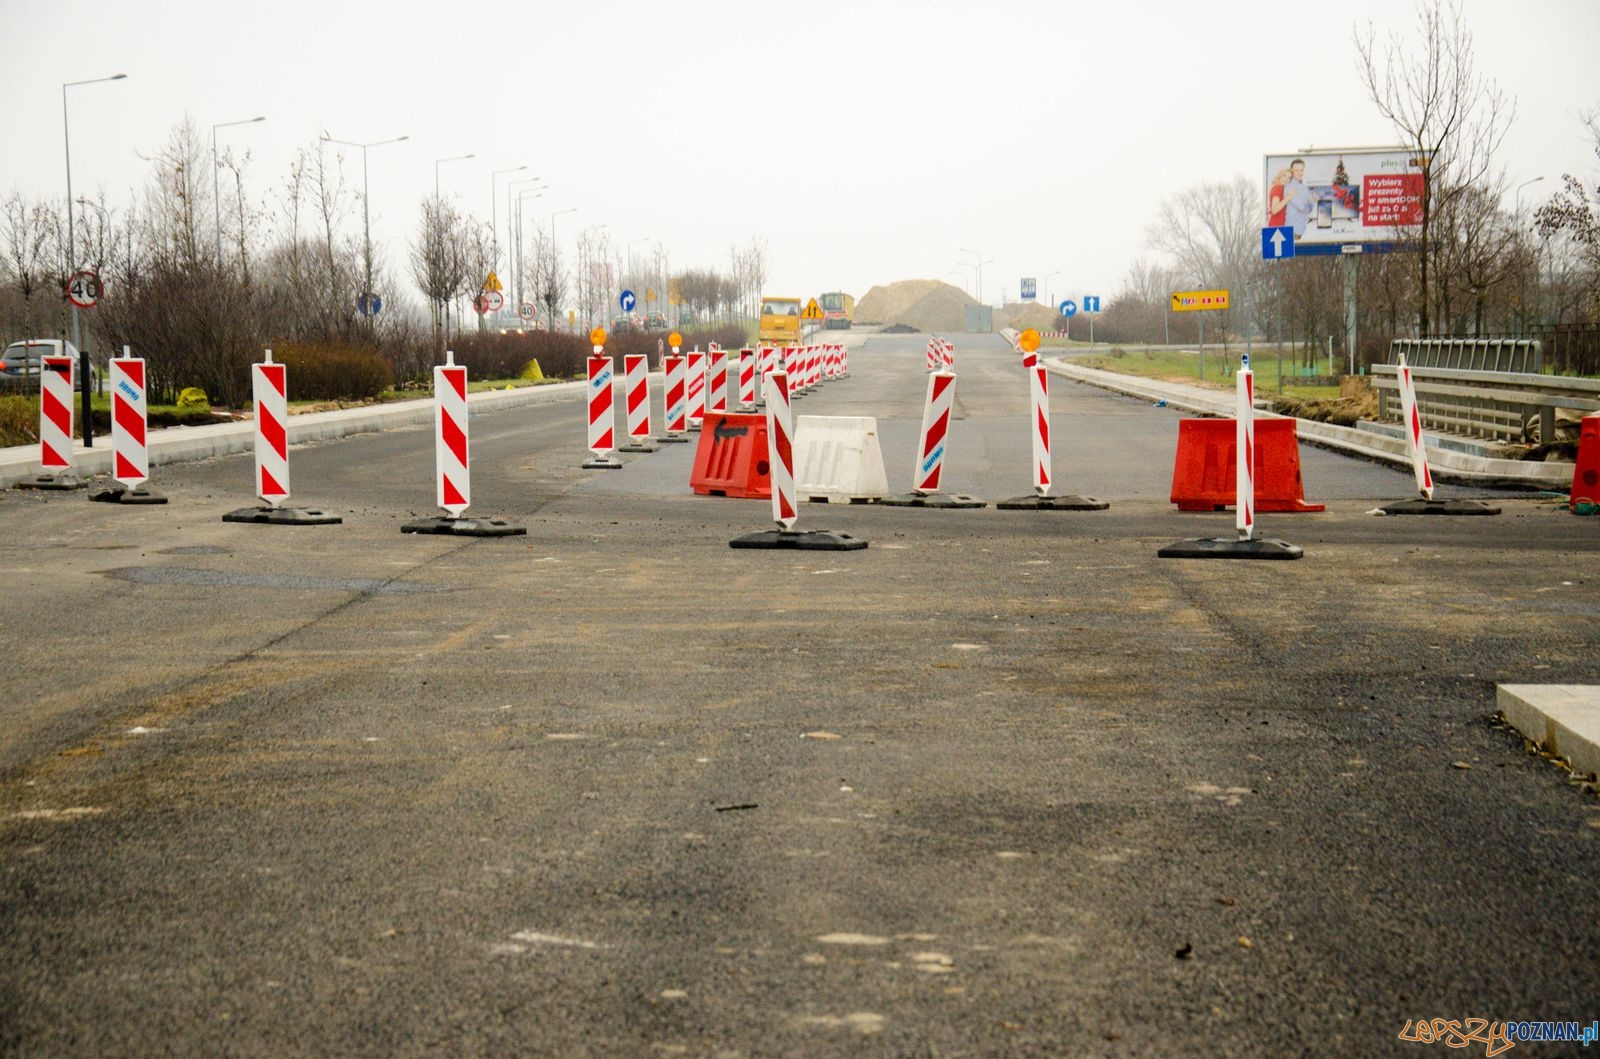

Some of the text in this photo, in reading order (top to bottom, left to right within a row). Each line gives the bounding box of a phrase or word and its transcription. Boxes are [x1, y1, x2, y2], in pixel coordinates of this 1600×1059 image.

[1369, 178, 1402, 187] Wybierz
[1368, 188, 1403, 196] prezenty
[71, 281, 97, 298] 40
